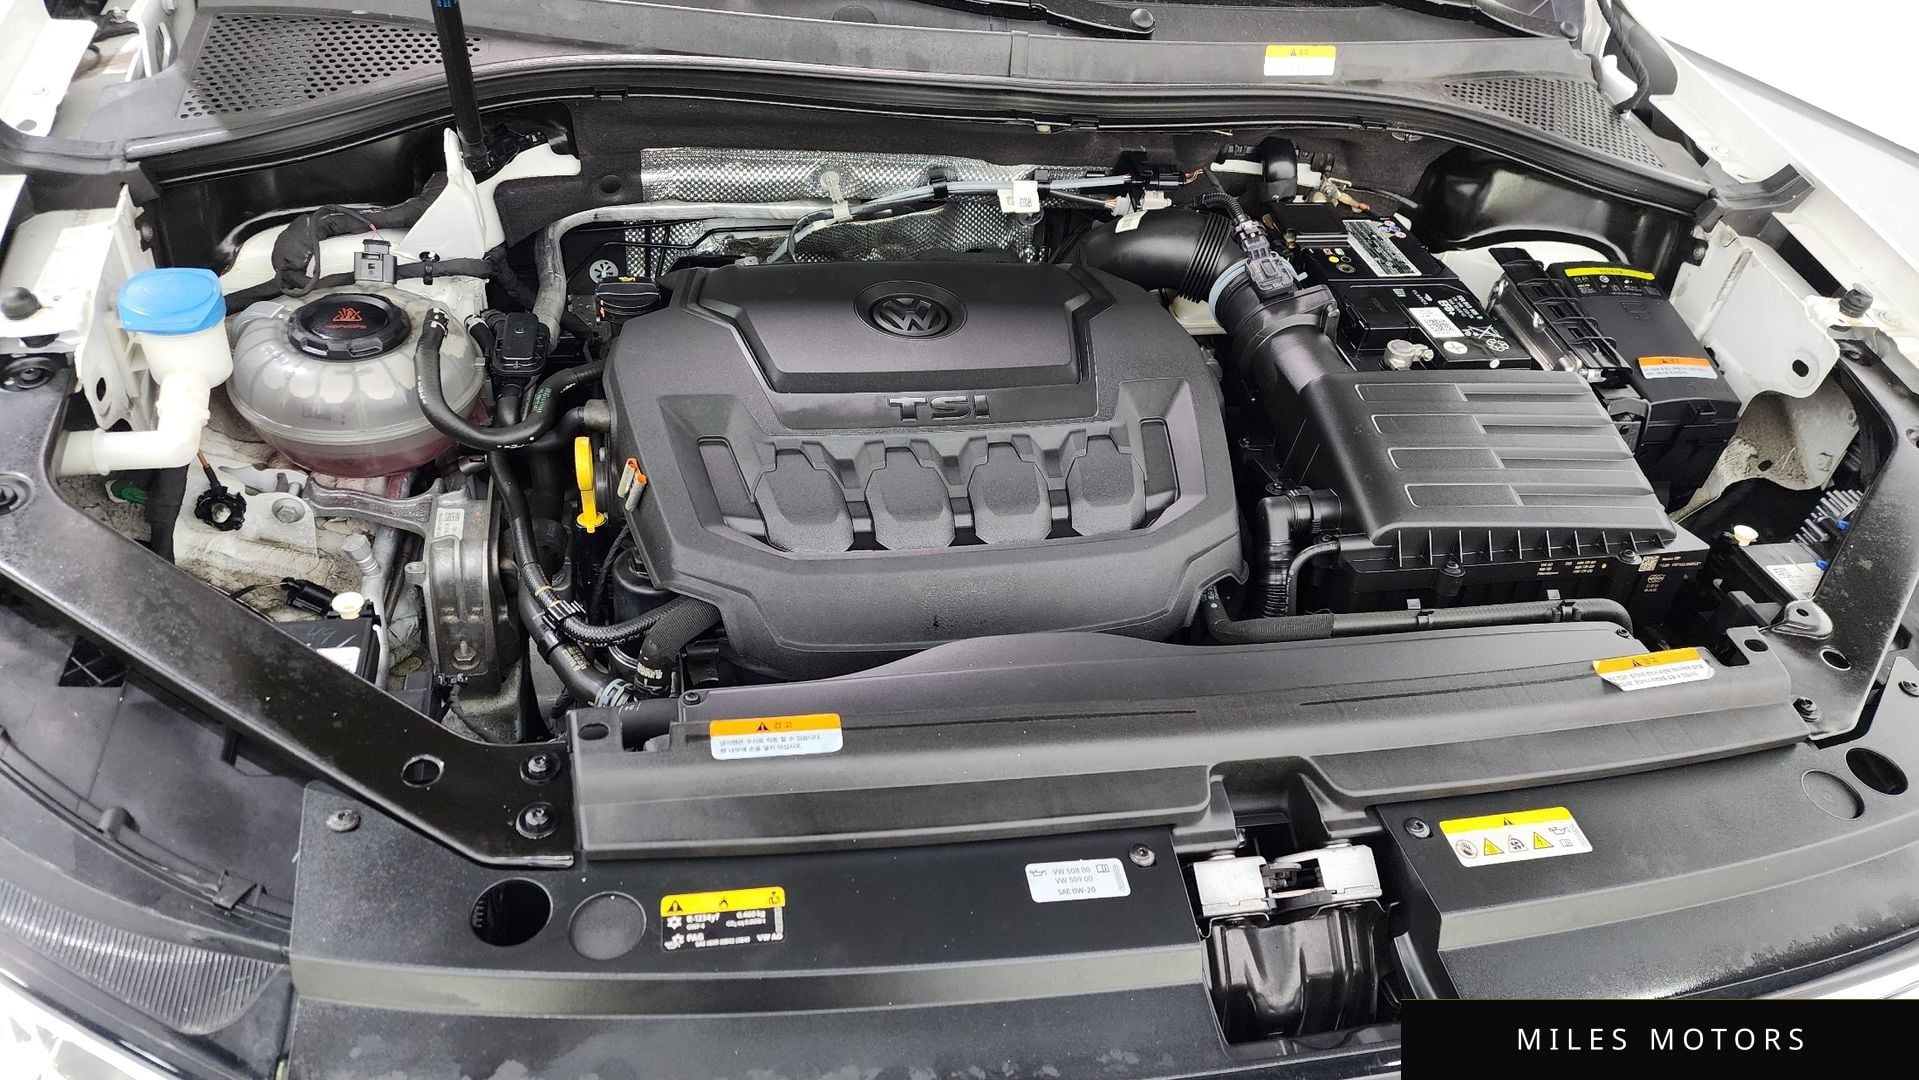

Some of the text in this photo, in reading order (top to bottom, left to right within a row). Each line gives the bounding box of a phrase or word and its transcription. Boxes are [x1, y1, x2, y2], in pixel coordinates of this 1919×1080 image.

[888, 395, 990, 421] TSI
[1071, 886, 1096, 894] 0W-20
[756, 933, 771, 942] VW
